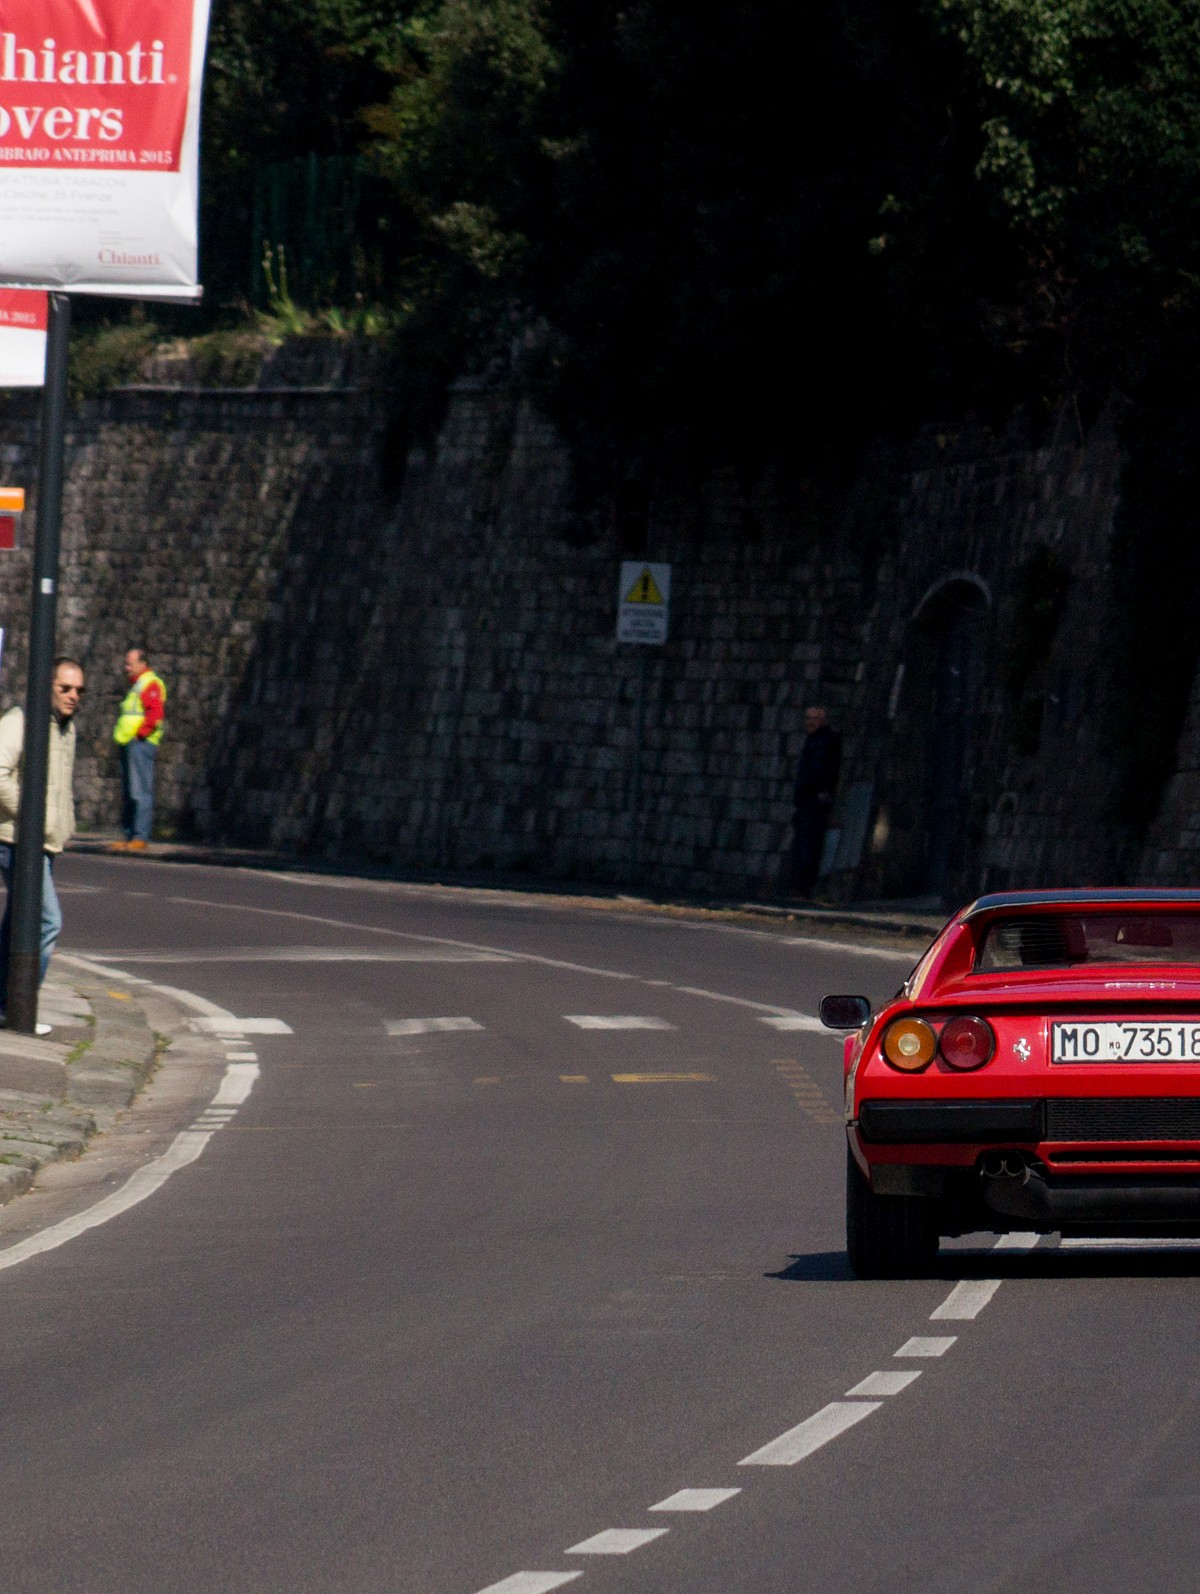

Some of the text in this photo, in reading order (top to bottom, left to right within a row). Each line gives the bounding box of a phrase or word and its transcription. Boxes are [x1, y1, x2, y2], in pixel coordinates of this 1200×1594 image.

[0, 32, 166, 85] hianti
[53, 148, 137, 163] ANTEPRIMA
[139, 150, 173, 164] 2015
[98, 248, 160, 266] Chianti
[1060, 1028, 1100, 1057] MO
